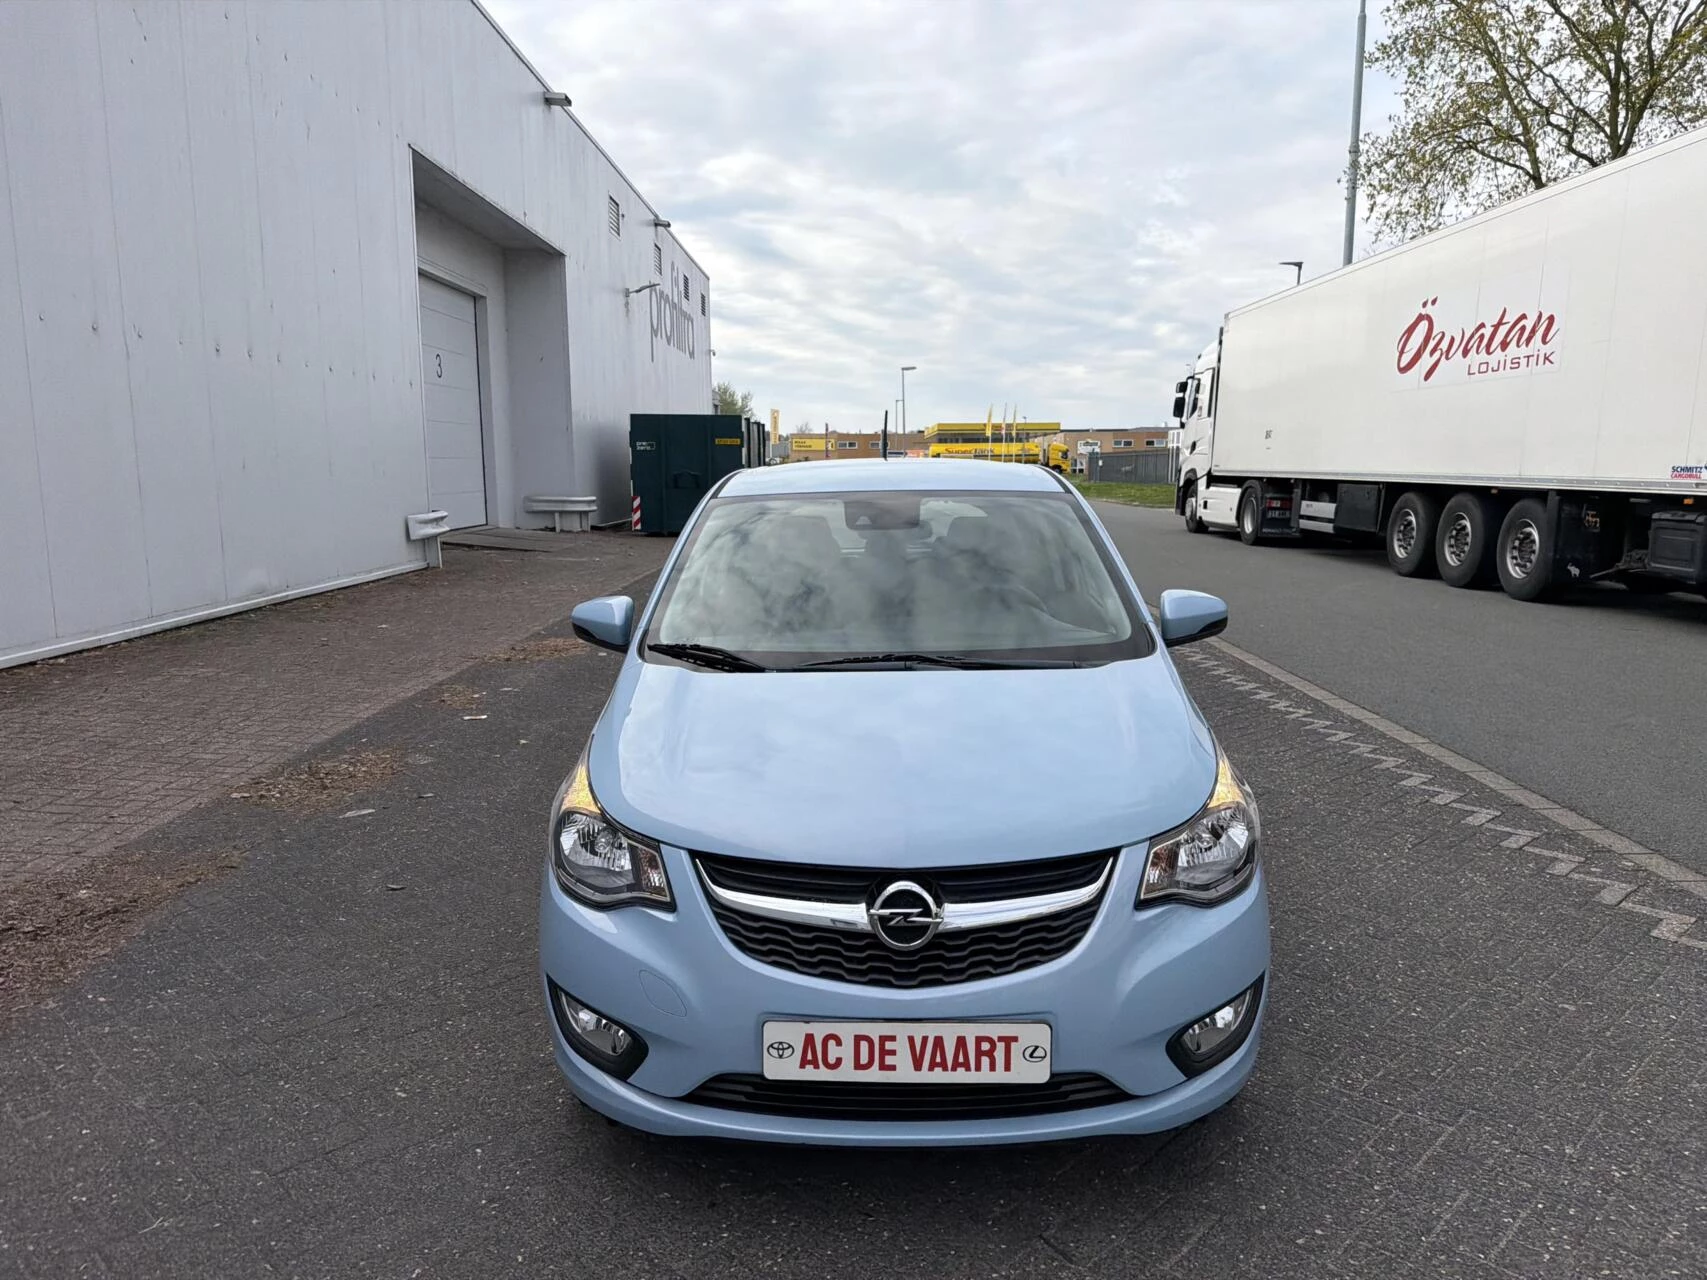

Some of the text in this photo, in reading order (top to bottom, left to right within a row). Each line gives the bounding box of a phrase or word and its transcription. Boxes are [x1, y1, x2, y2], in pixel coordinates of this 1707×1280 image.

[1396, 296, 1560, 381] Özvatan
[435, 353, 443, 378] 3
[1467, 349, 1556, 376] LOJİSTİK
[1671, 465, 1703, 473] SCHMITZ
[799, 1033, 1019, 1072] AC DE VAART
